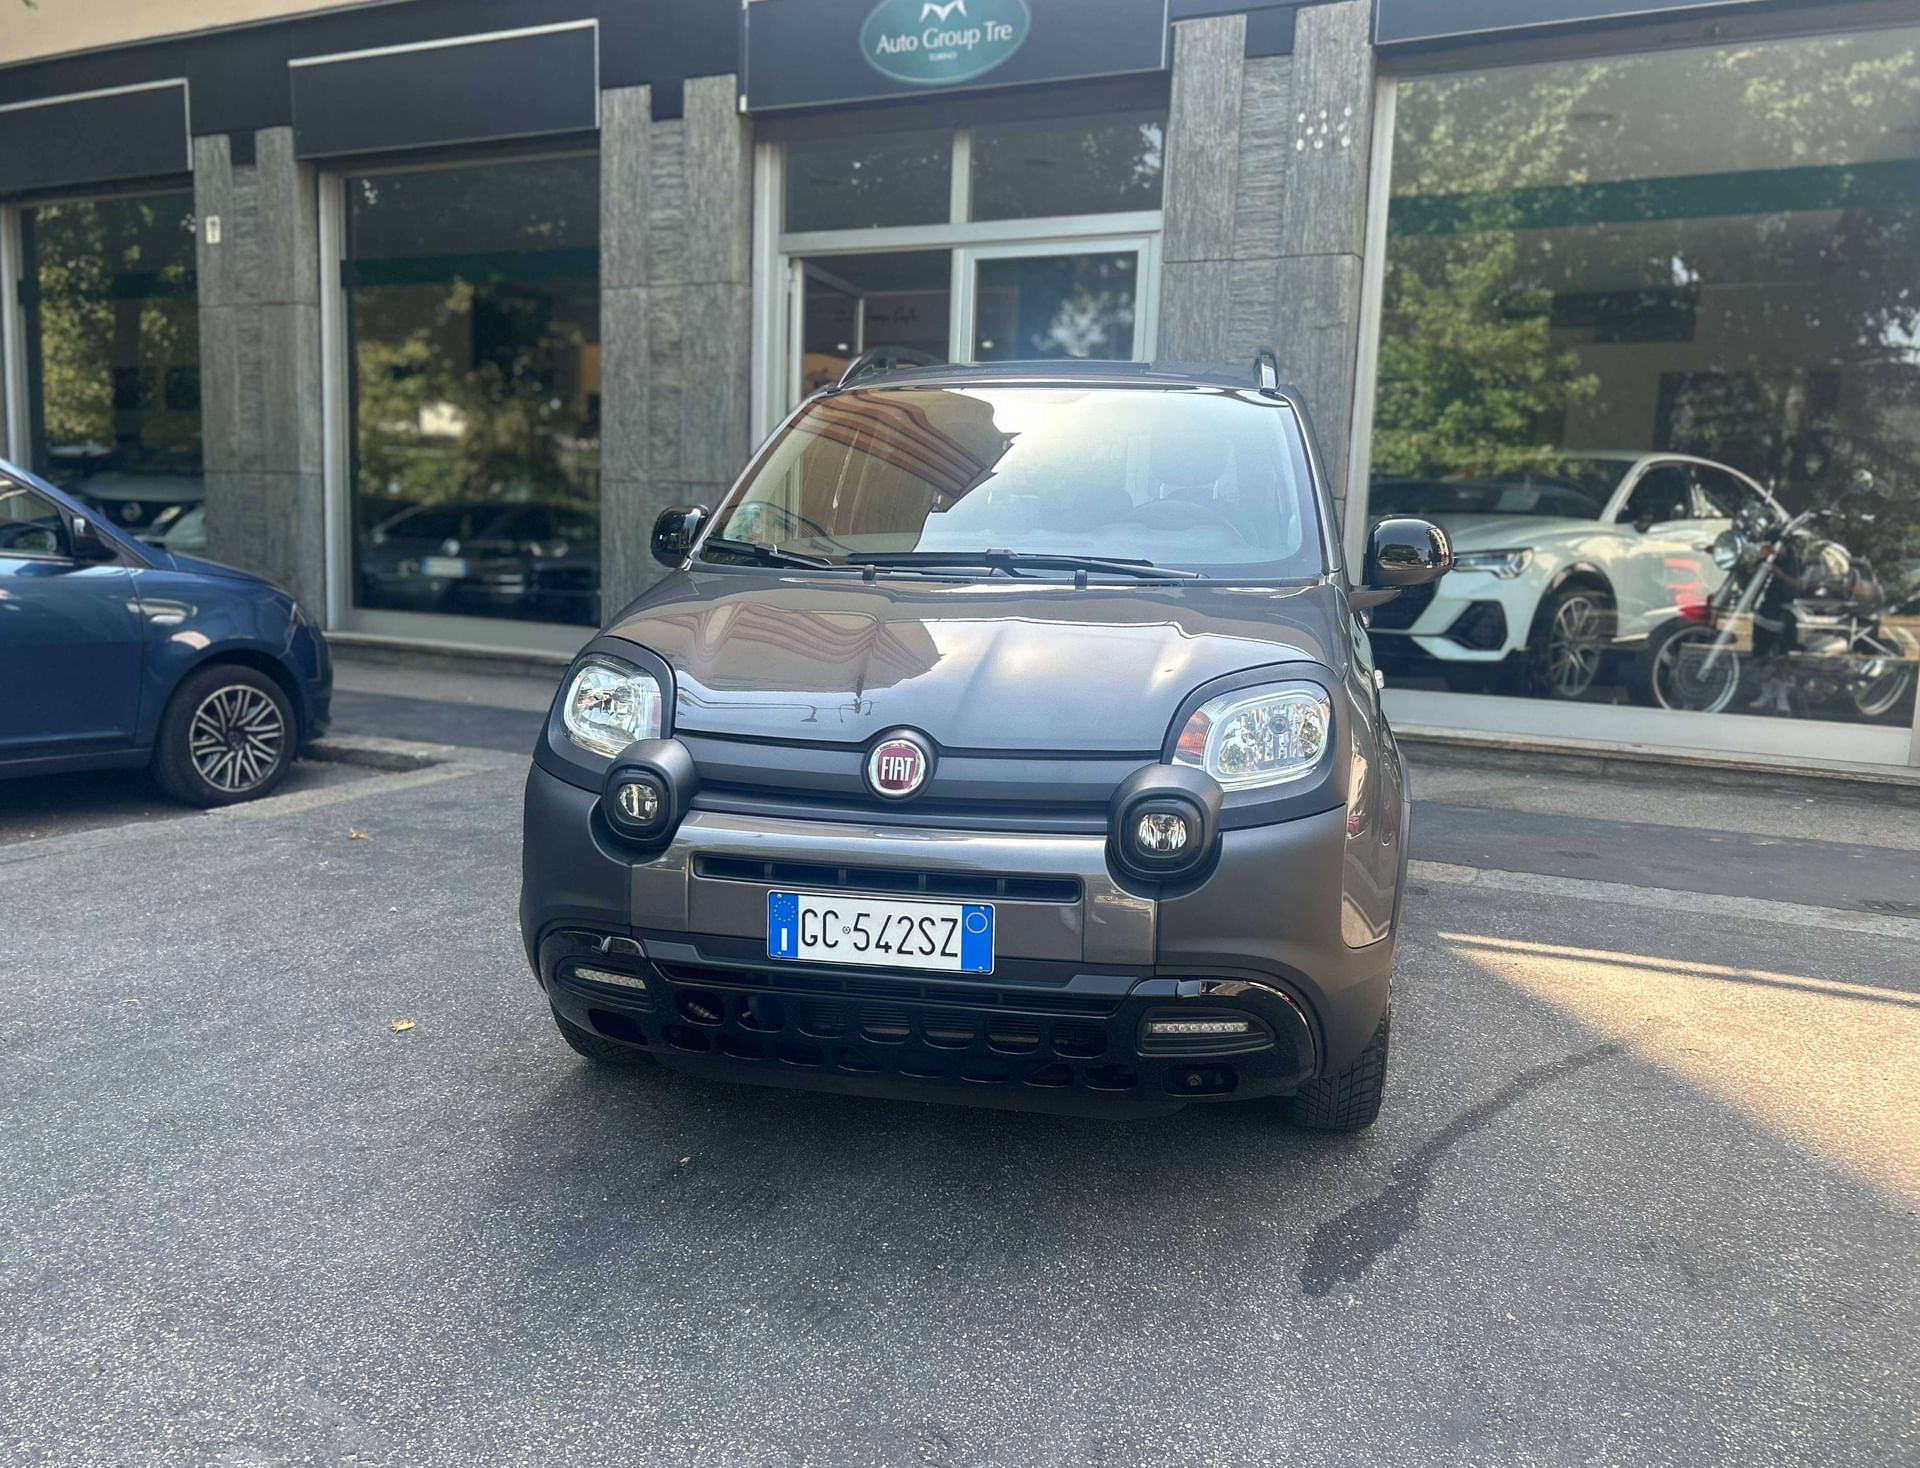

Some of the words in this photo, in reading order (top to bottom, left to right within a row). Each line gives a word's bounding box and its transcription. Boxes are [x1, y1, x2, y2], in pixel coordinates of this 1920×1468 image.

[875, 33, 918, 55] Auto
[922, 27, 981, 51] Group
[983, 20, 1013, 42] Tre
[881, 756, 914, 781] FIAT
[801, 908, 839, 948] GC
[853, 912, 959, 958] 542SZ
